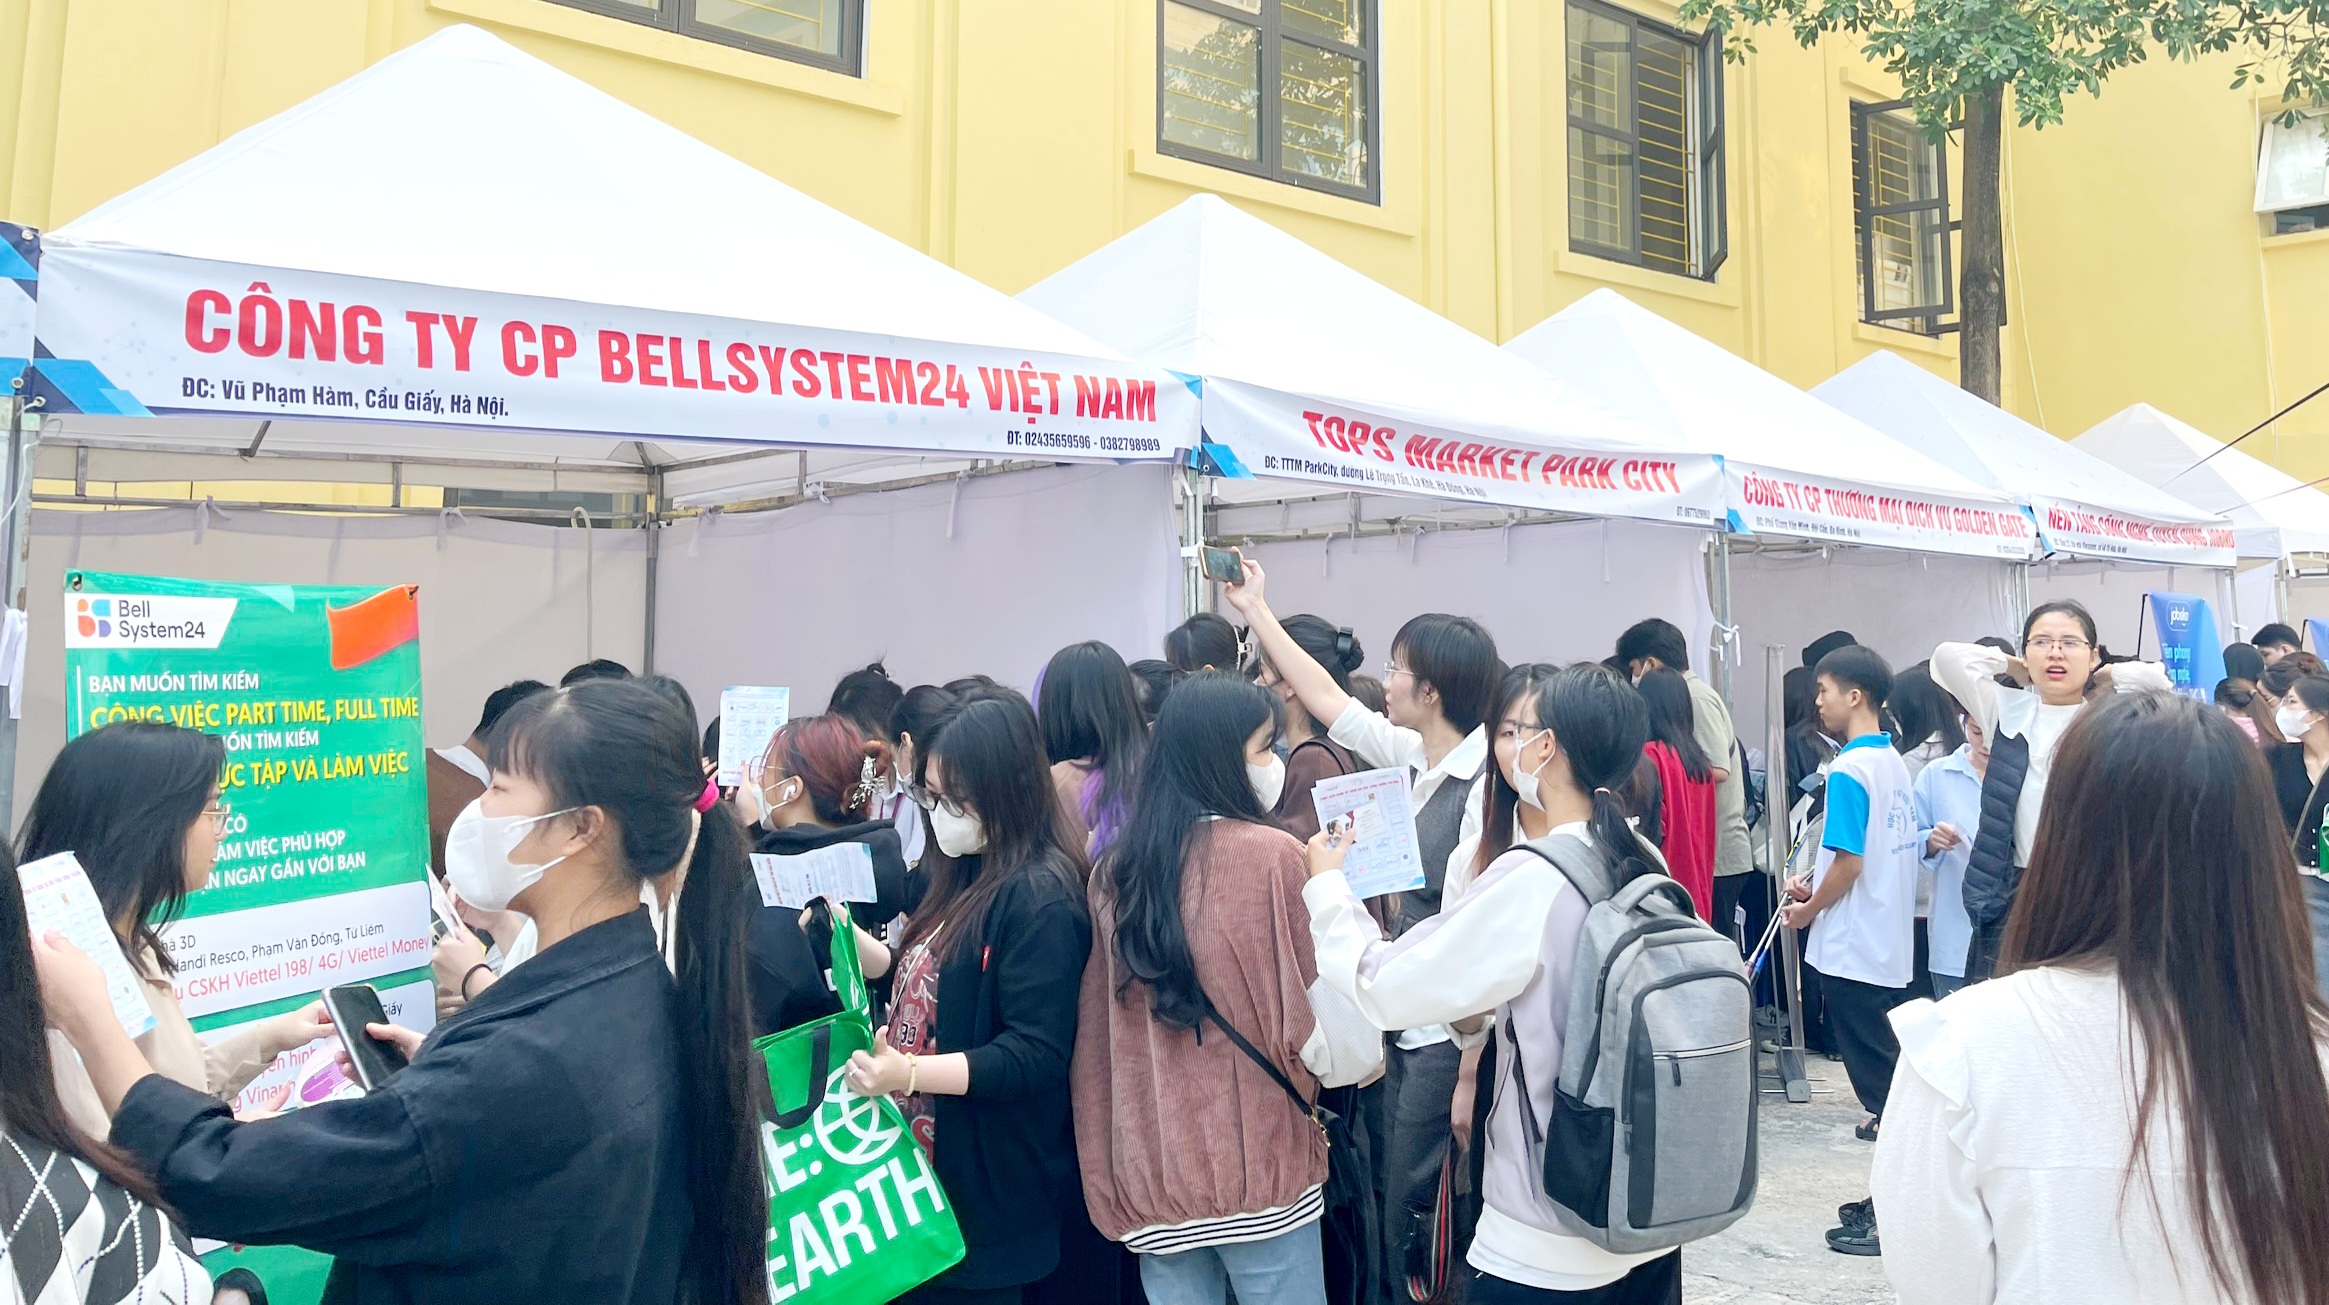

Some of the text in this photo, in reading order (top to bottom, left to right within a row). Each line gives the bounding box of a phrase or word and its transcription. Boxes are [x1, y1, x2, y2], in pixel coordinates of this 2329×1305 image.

[185, 281, 1157, 425] CÔNG TY CP BELLSYSTEM24 VIỆT NAM
[182, 376, 509, 419] ĐC: Vũ Phạm Hàm, Cầu Giấy, Hà Nội.
[1007, 430, 1022, 446] ĐT:
[1025, 431, 1091, 449] 02435659596
[1100, 436, 1161, 451] 0382798989
[1302, 410, 1682, 494] TOPS MARKET PARK CITY
[1281, 457, 1302, 472] TTTM
[1304, 460, 1339, 478] ParkCity,
[1743, 470, 2029, 538] CÔNG TY CP THƯƠNG MẠI DỊCH VỤ GOLDEN GATE
[119, 600, 150, 618] Bell
[119, 620, 206, 643] System24
[89, 669, 260, 697] BẠN MUỐN TÌM KIẾM
[170, 700, 221, 732] VIỆC
[226, 701, 276, 726] PART
[281, 700, 332, 725] TIME,
[335, 699, 377, 720] FULL
[380, 697, 419, 718] TIME
[255, 729, 282, 749] TÌM
[286, 727, 320, 748] KIẾM
[250, 758, 287, 790] TẬP
[291, 754, 319, 782] VÀ
[323, 752, 364, 780] LÀM
[368, 748, 409, 779] VIỆC
[245, 836, 279, 860] VIỆC
[282, 831, 312, 853] PHÙ
[315, 829, 346, 851] HỢP
[224, 865, 267, 887] NGAY
[307, 854, 334, 875] VỚI
[338, 852, 366, 873] BẠN
[180, 934, 196, 949] 3D
[210, 950, 249, 966] Resco,
[252, 942, 283, 959] Phạm
[188, 973, 230, 997] CSKH
[234, 963, 281, 988] Viettel
[285, 956, 314, 977] 198/
[318, 947, 344, 970] 4G/
[348, 941, 389, 964] Viettel
[392, 936, 430, 954] Money
[766, 1148, 945, 1305] EARTH
